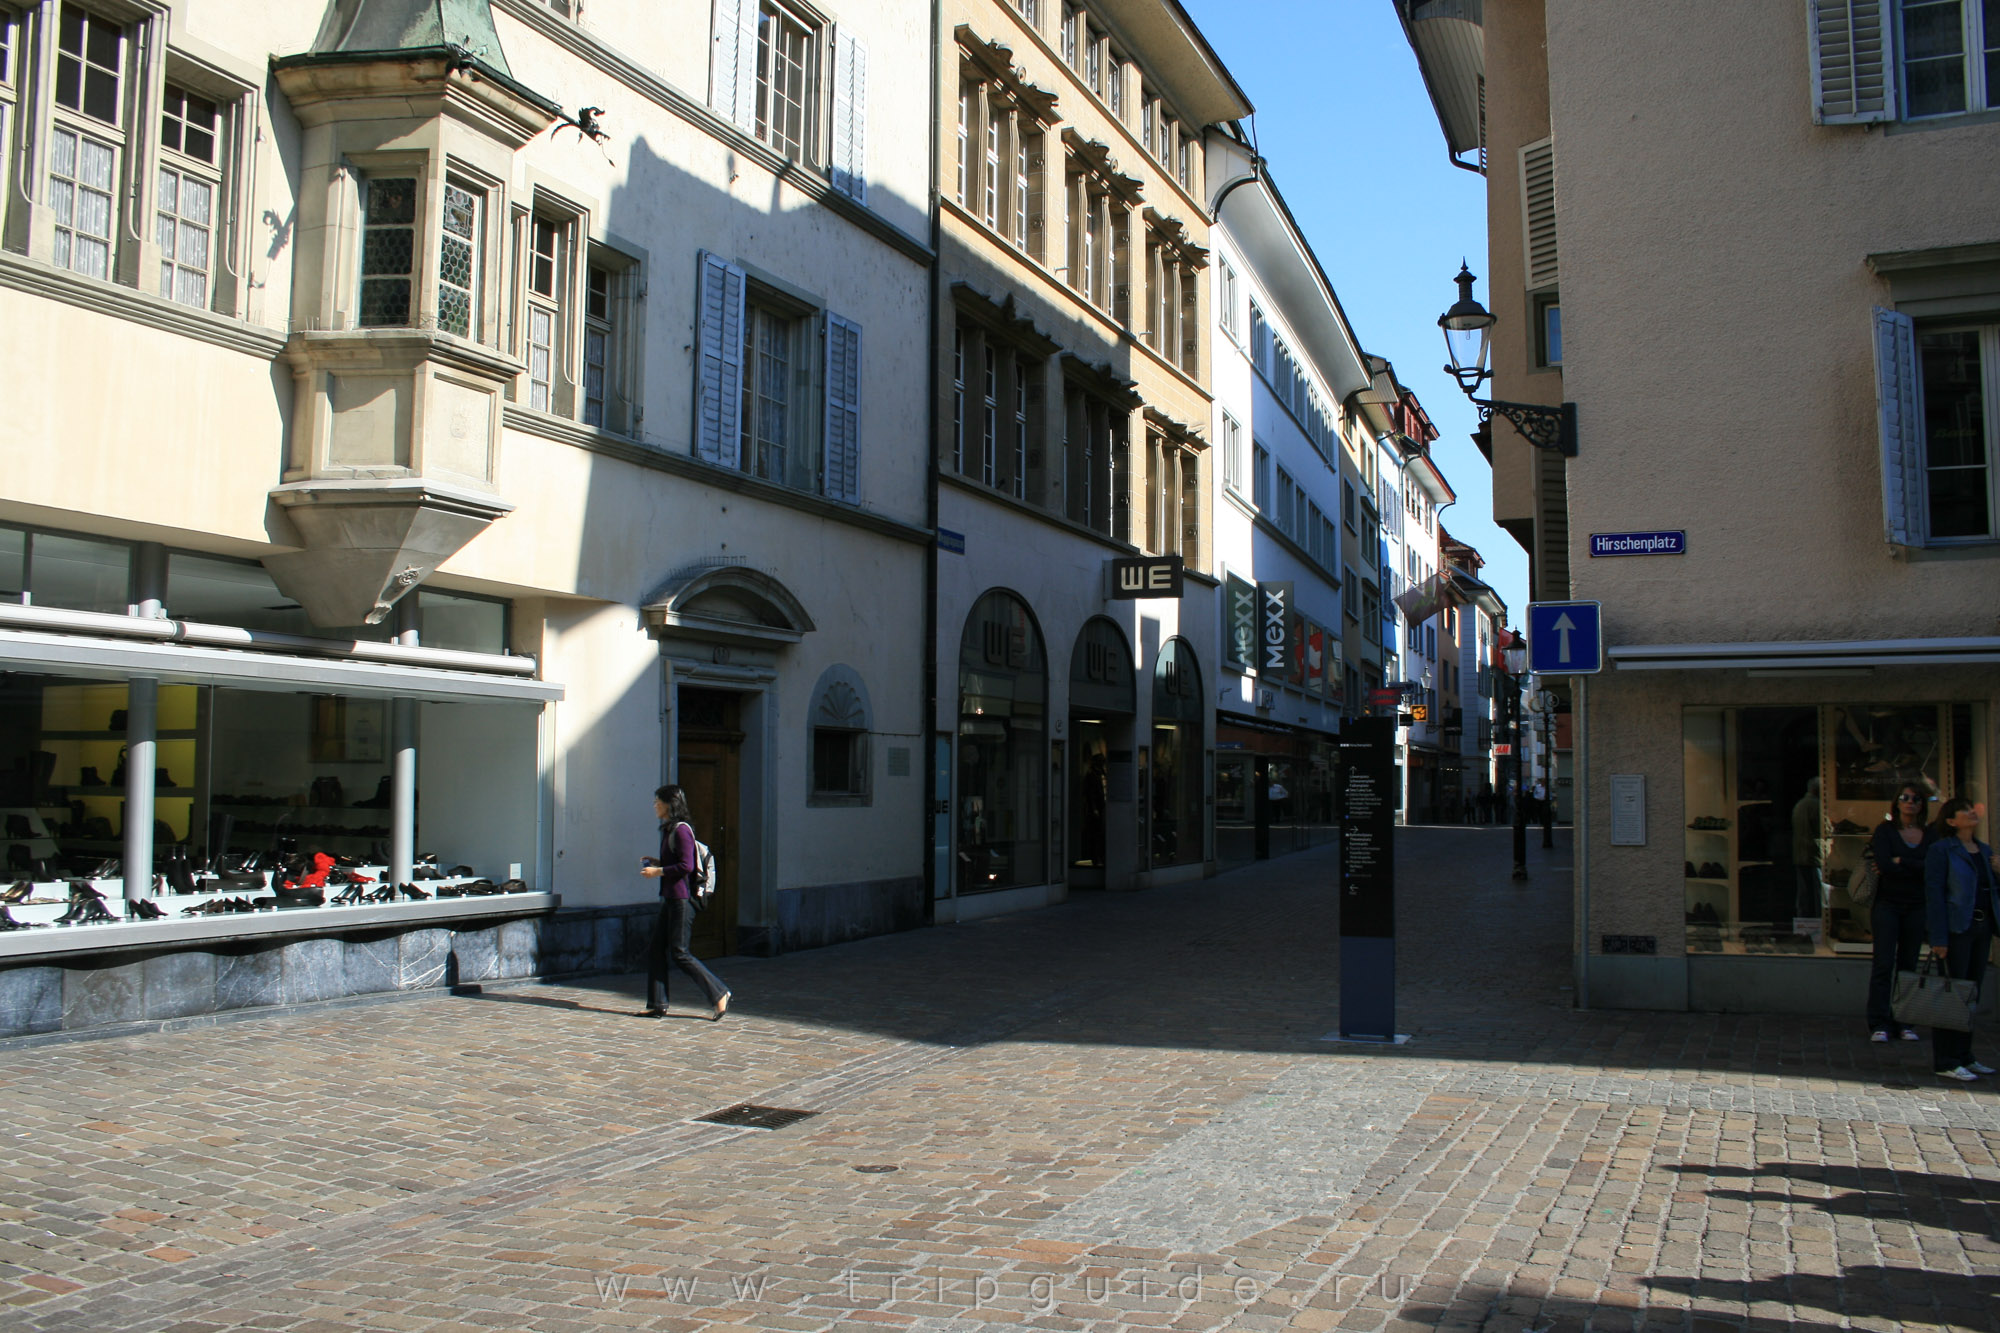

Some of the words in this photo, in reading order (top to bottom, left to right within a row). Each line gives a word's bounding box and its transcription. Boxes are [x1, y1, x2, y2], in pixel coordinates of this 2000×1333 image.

[1596, 535, 1677, 552] Hirschenplatz
[1120, 565, 1173, 591] WE
[983, 620, 1026, 668] WE
[1087, 642, 1119, 684] WE
